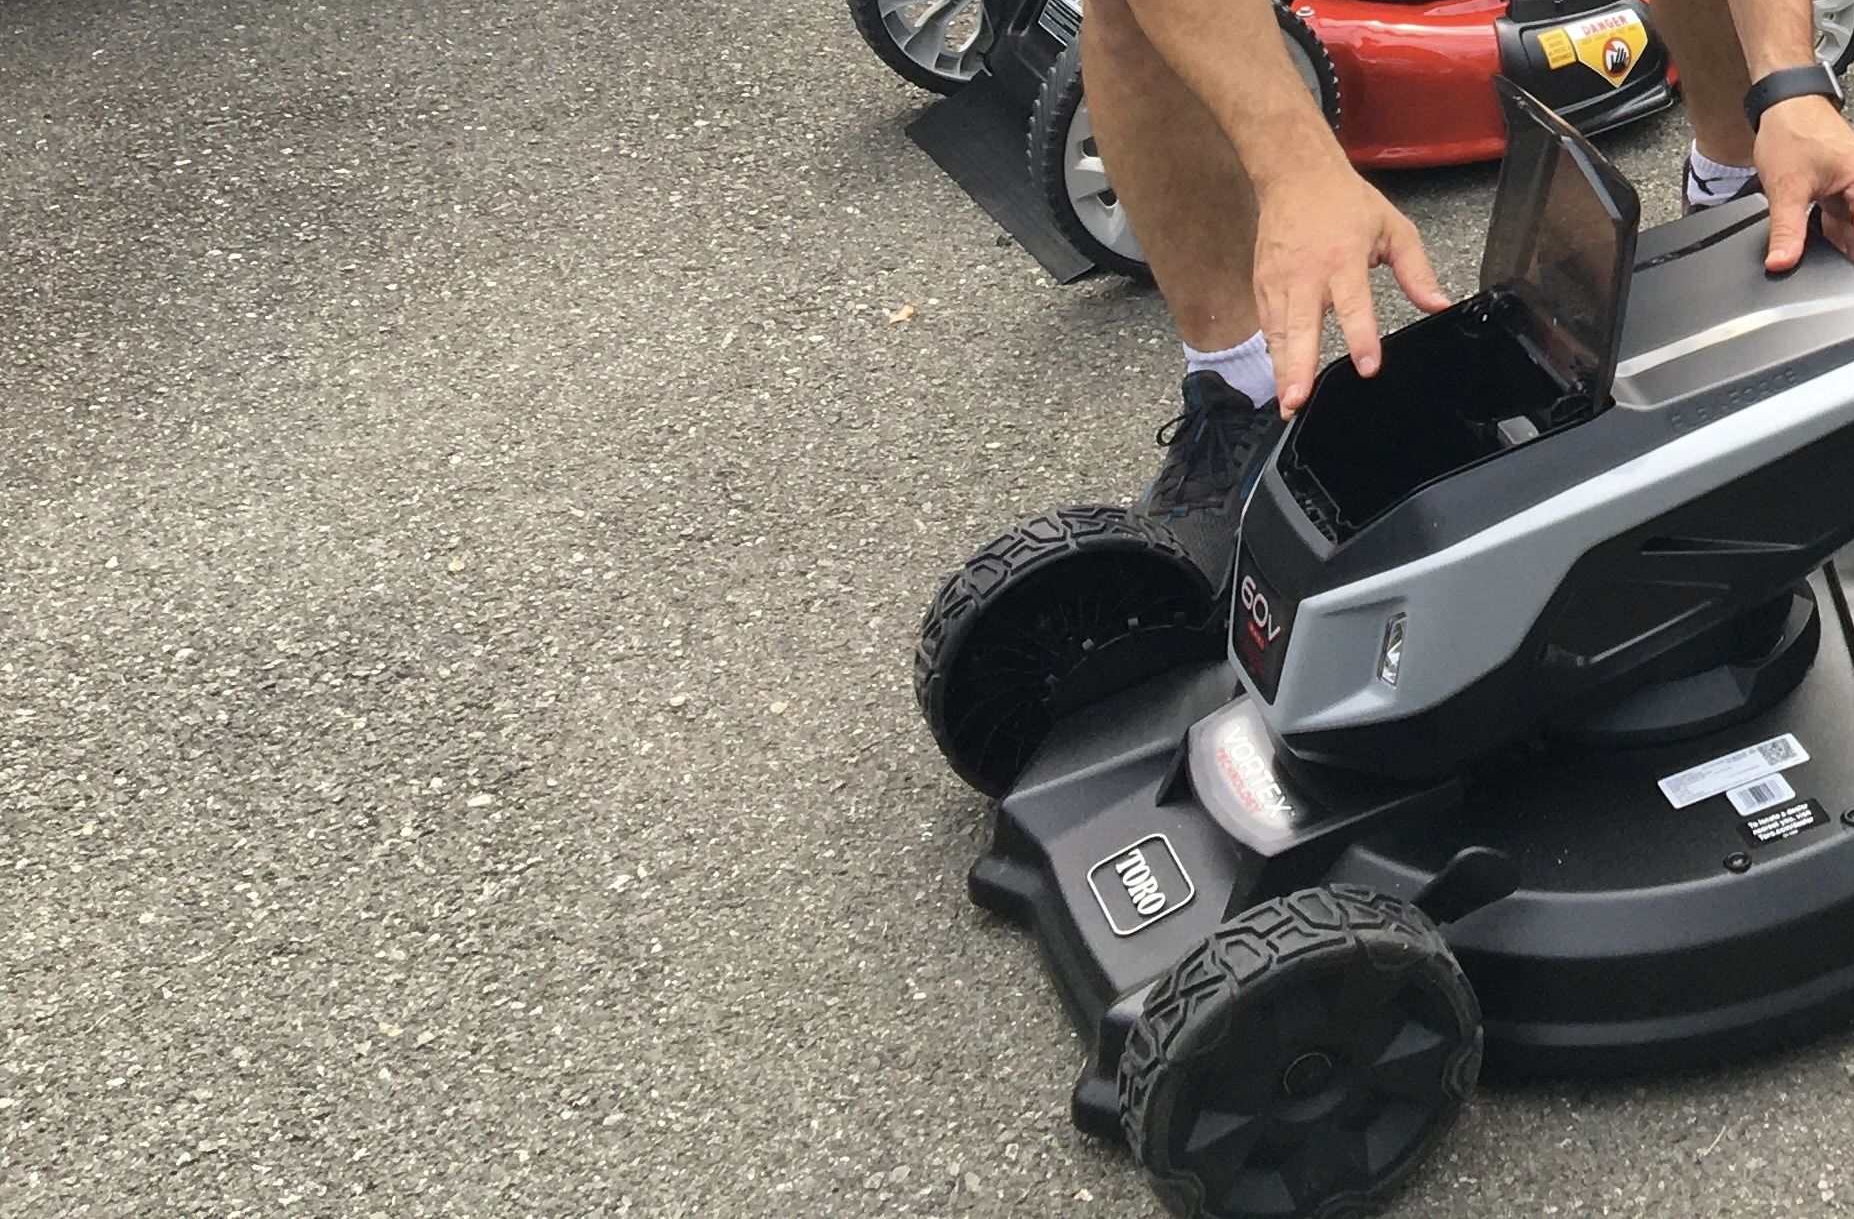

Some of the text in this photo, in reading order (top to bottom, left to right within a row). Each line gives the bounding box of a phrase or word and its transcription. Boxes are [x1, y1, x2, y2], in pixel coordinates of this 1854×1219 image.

[1581, 15, 1629, 36] DANGER
[1241, 575, 1281, 641] 60V
[1223, 725, 1292, 819] VORTEX
[1115, 848, 1166, 916] TORO
